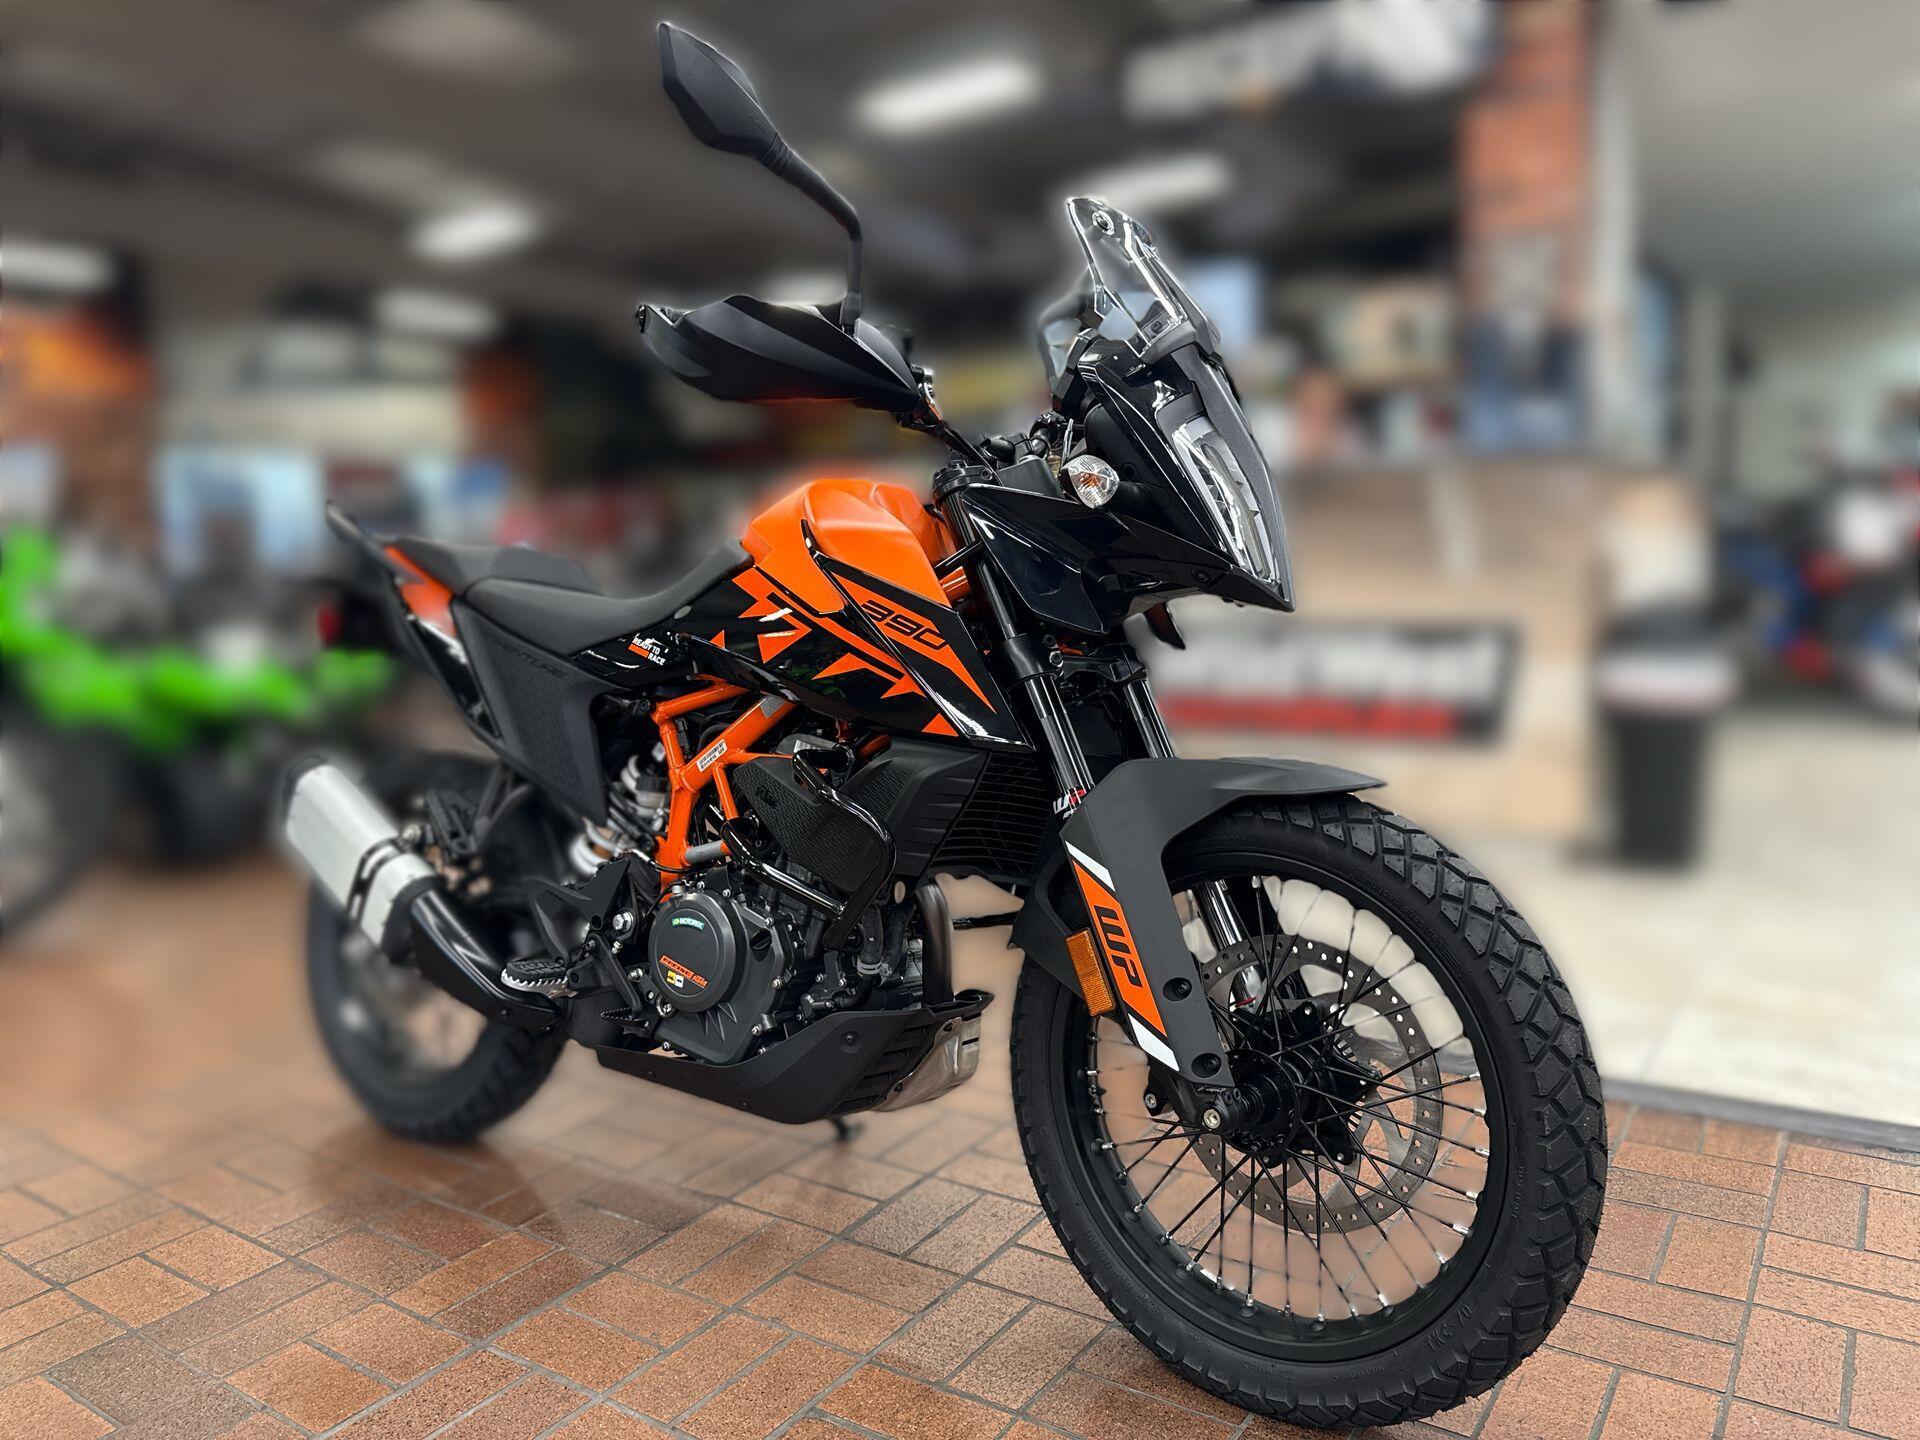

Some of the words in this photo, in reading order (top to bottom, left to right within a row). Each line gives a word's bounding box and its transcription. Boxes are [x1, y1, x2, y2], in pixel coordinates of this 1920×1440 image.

[861, 599, 949, 650] 390
[632, 637, 653, 651] READY
[652, 645, 661, 655] TO
[648, 652, 666, 666] RACE
[1094, 905, 1143, 988] WP
